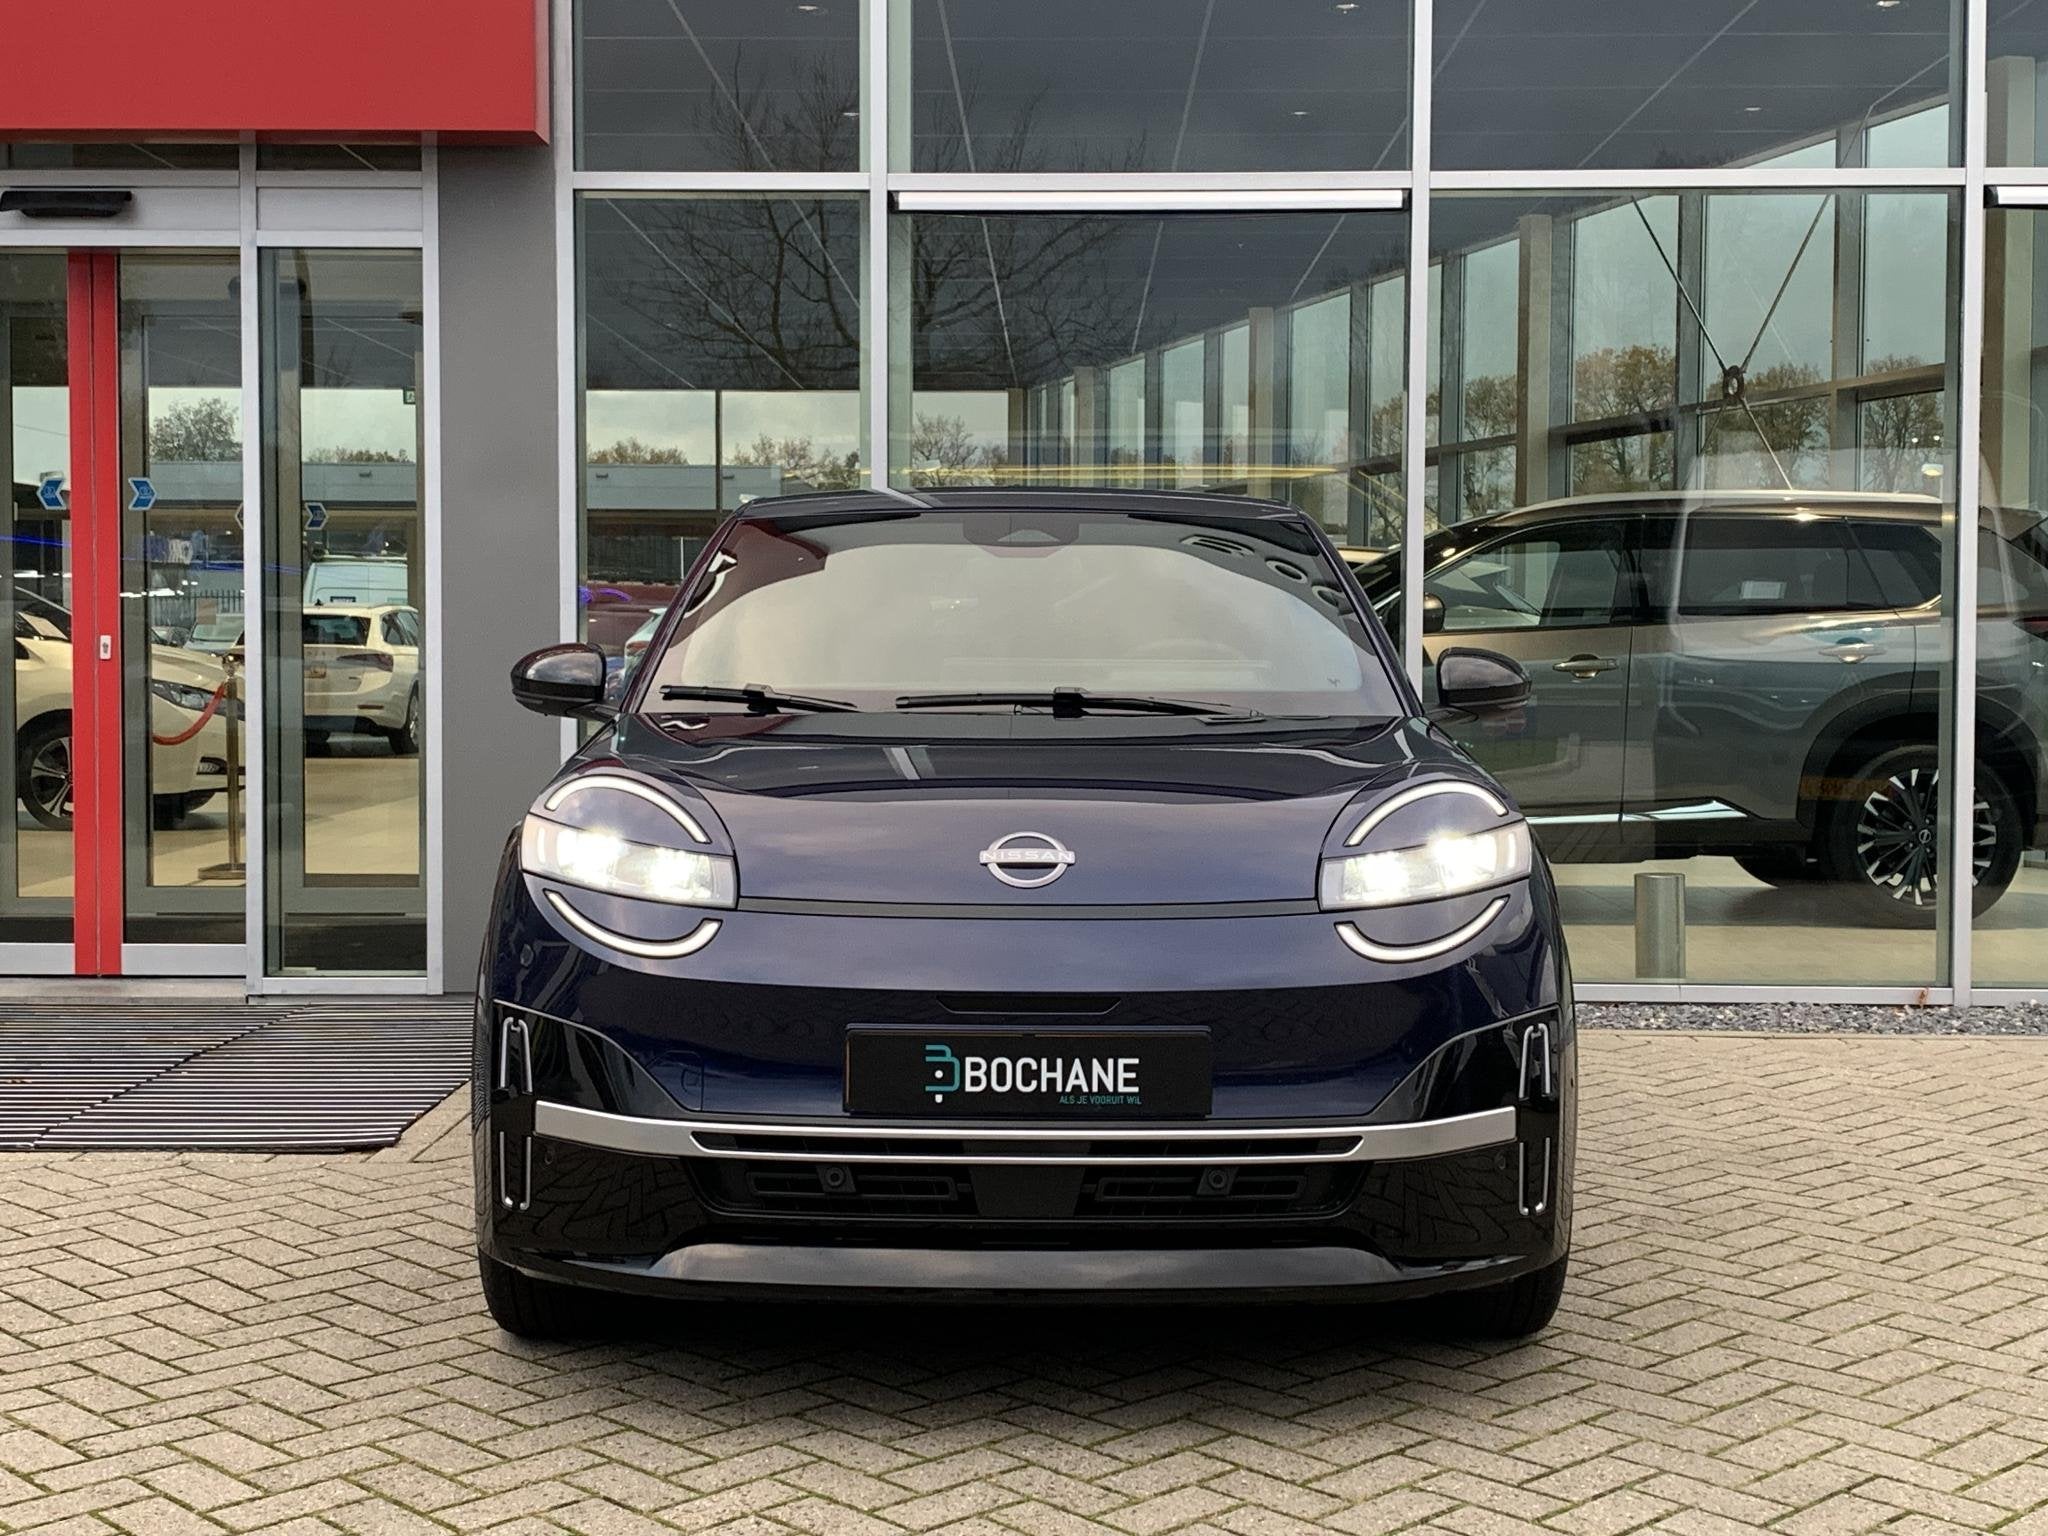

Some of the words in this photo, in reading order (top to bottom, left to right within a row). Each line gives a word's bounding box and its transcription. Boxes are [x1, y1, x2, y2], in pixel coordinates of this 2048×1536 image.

[982, 850, 1072, 861] NISSAN
[964, 1057, 1140, 1093] BOCHANE
[1059, 1095, 1075, 1104] ALS
[1077, 1095, 1088, 1104] JE
[1089, 1095, 1125, 1104] VOORUIT
